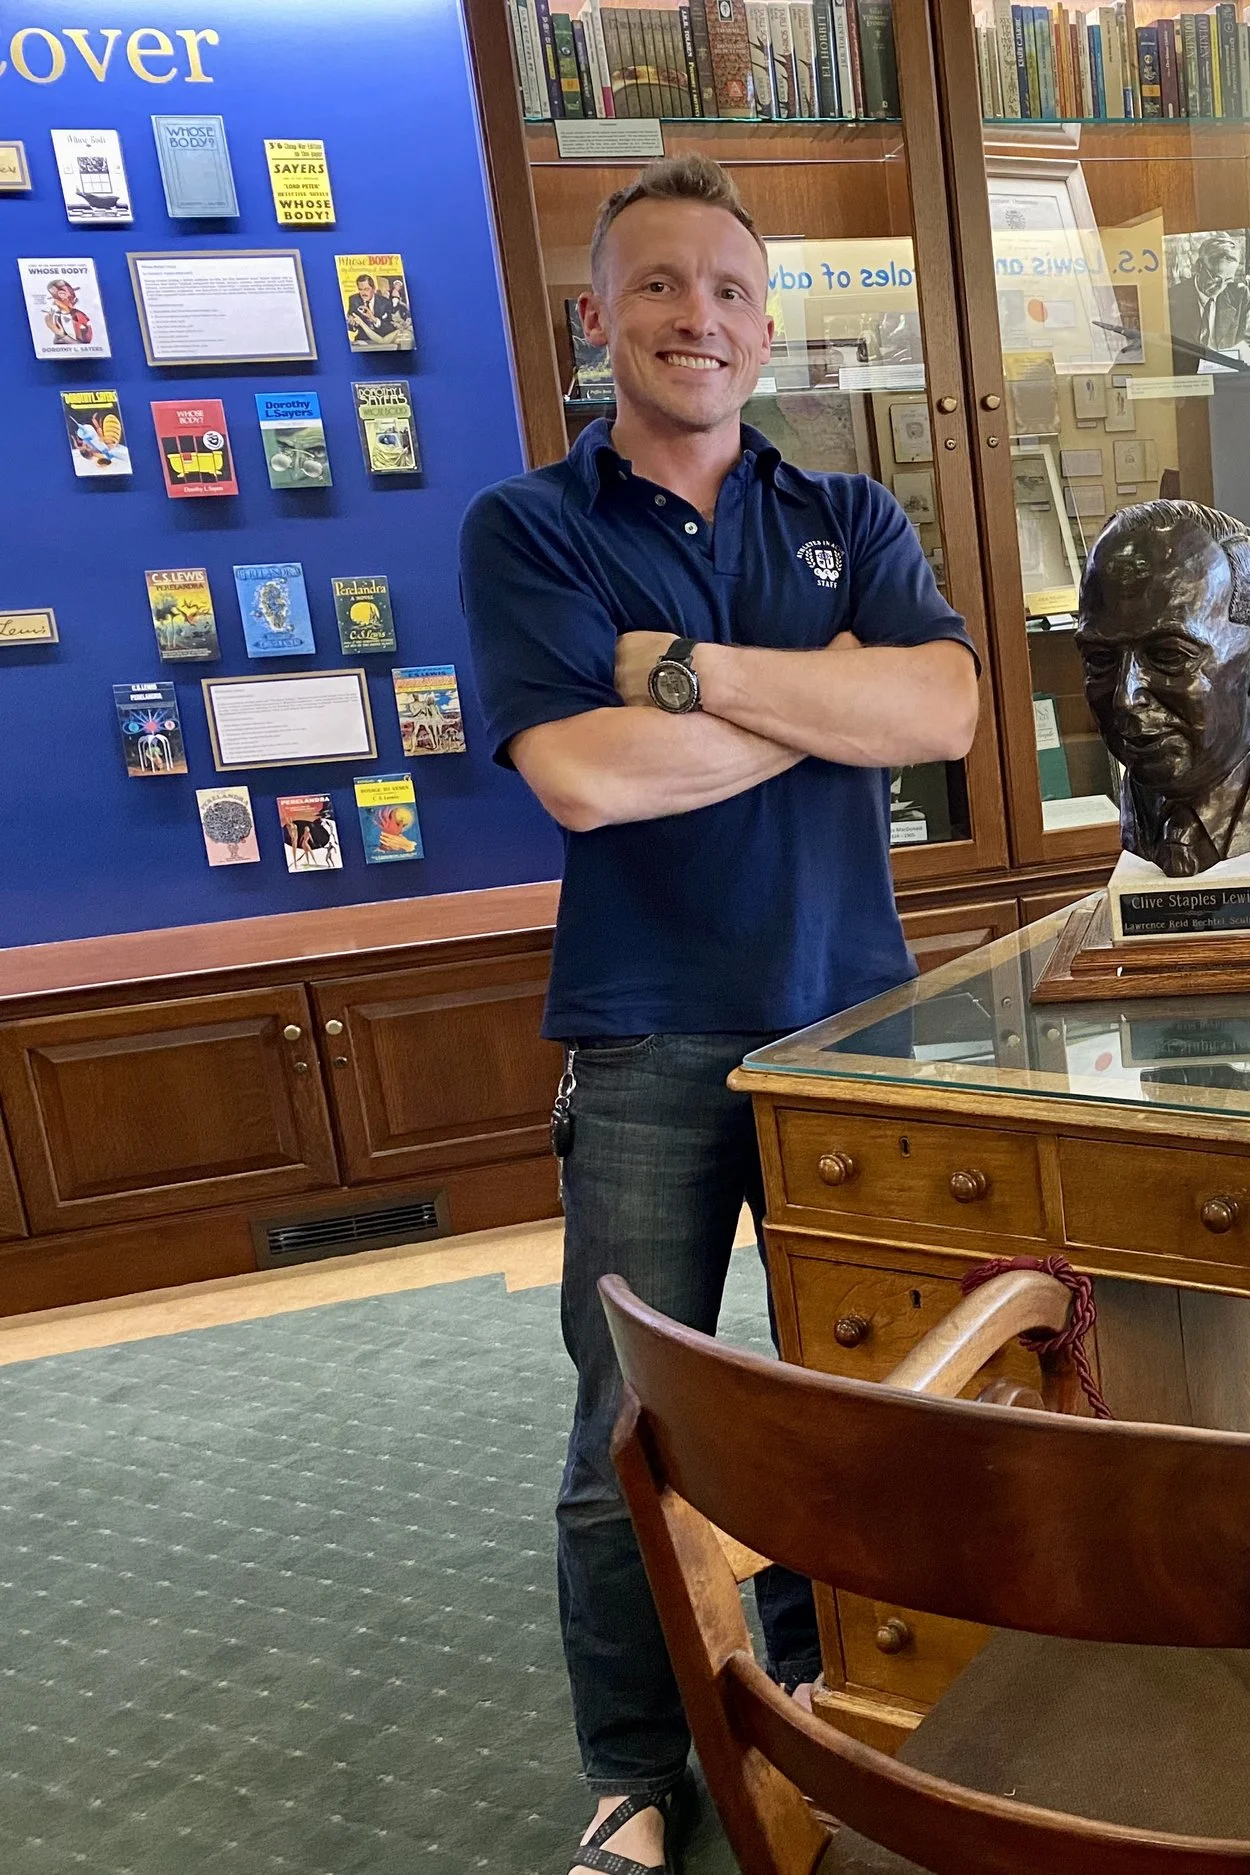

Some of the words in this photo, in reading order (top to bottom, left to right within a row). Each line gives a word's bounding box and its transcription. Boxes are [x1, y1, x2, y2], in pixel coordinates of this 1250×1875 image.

[818, 16, 829, 59] HOBBIT
[1184, 16, 1196, 59] TOLKIEN
[1198, 16, 1209, 58] TOLKIEN
[0, 26, 219, 83] over
[165, 127, 215, 137] WHOSE
[170, 137, 215, 148] BODY?
[274, 164, 324, 174] SAYERS
[279, 200, 331, 209] WHOSE
[284, 211, 330, 220] BODY?
[265, 400, 310, 410] Dorothy
[334, 580, 387, 596] Perelandra
[817, 580, 838, 589] STAFF
[280, 796, 330, 805] PERELANDRA
[1131, 896, 1164, 910] Clive
[1169, 892, 1217, 910] Staples
[1124, 921, 1166, 931] Lawrence
[1169, 919, 1189, 929] Reid
